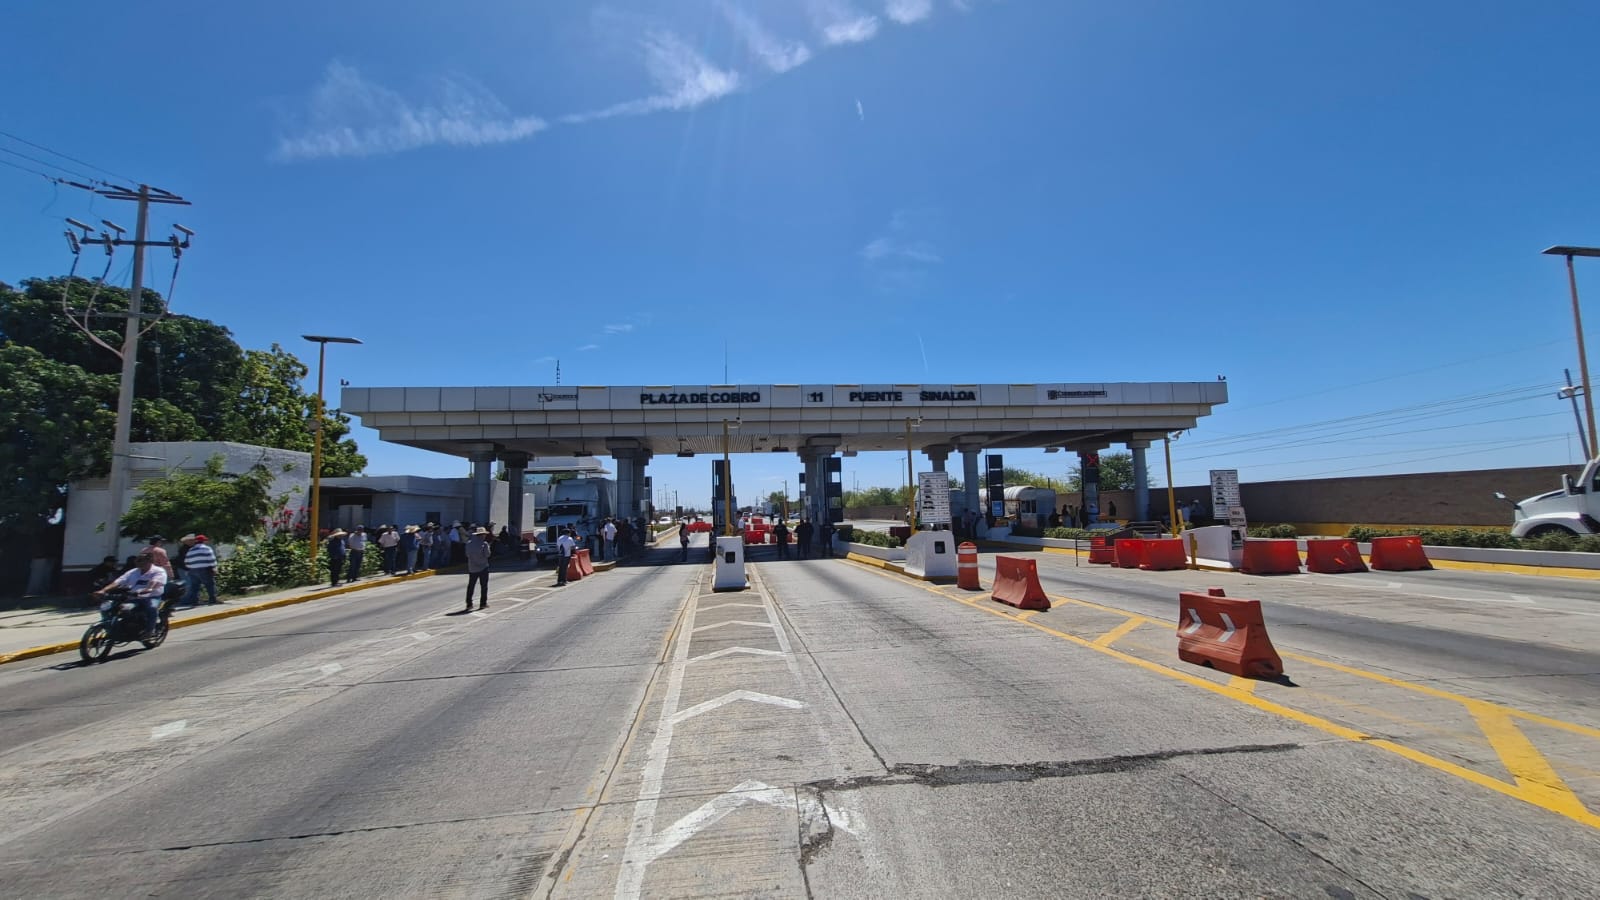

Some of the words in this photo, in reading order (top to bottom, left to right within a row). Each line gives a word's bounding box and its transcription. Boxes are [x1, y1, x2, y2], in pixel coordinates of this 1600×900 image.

[640, 393, 688, 404] PLAZA
[688, 393, 708, 404] DE
[710, 392, 761, 403] COBRO
[810, 391, 824, 402] 11
[850, 391, 903, 402] PUENTE
[919, 391, 977, 401] SINALOA
